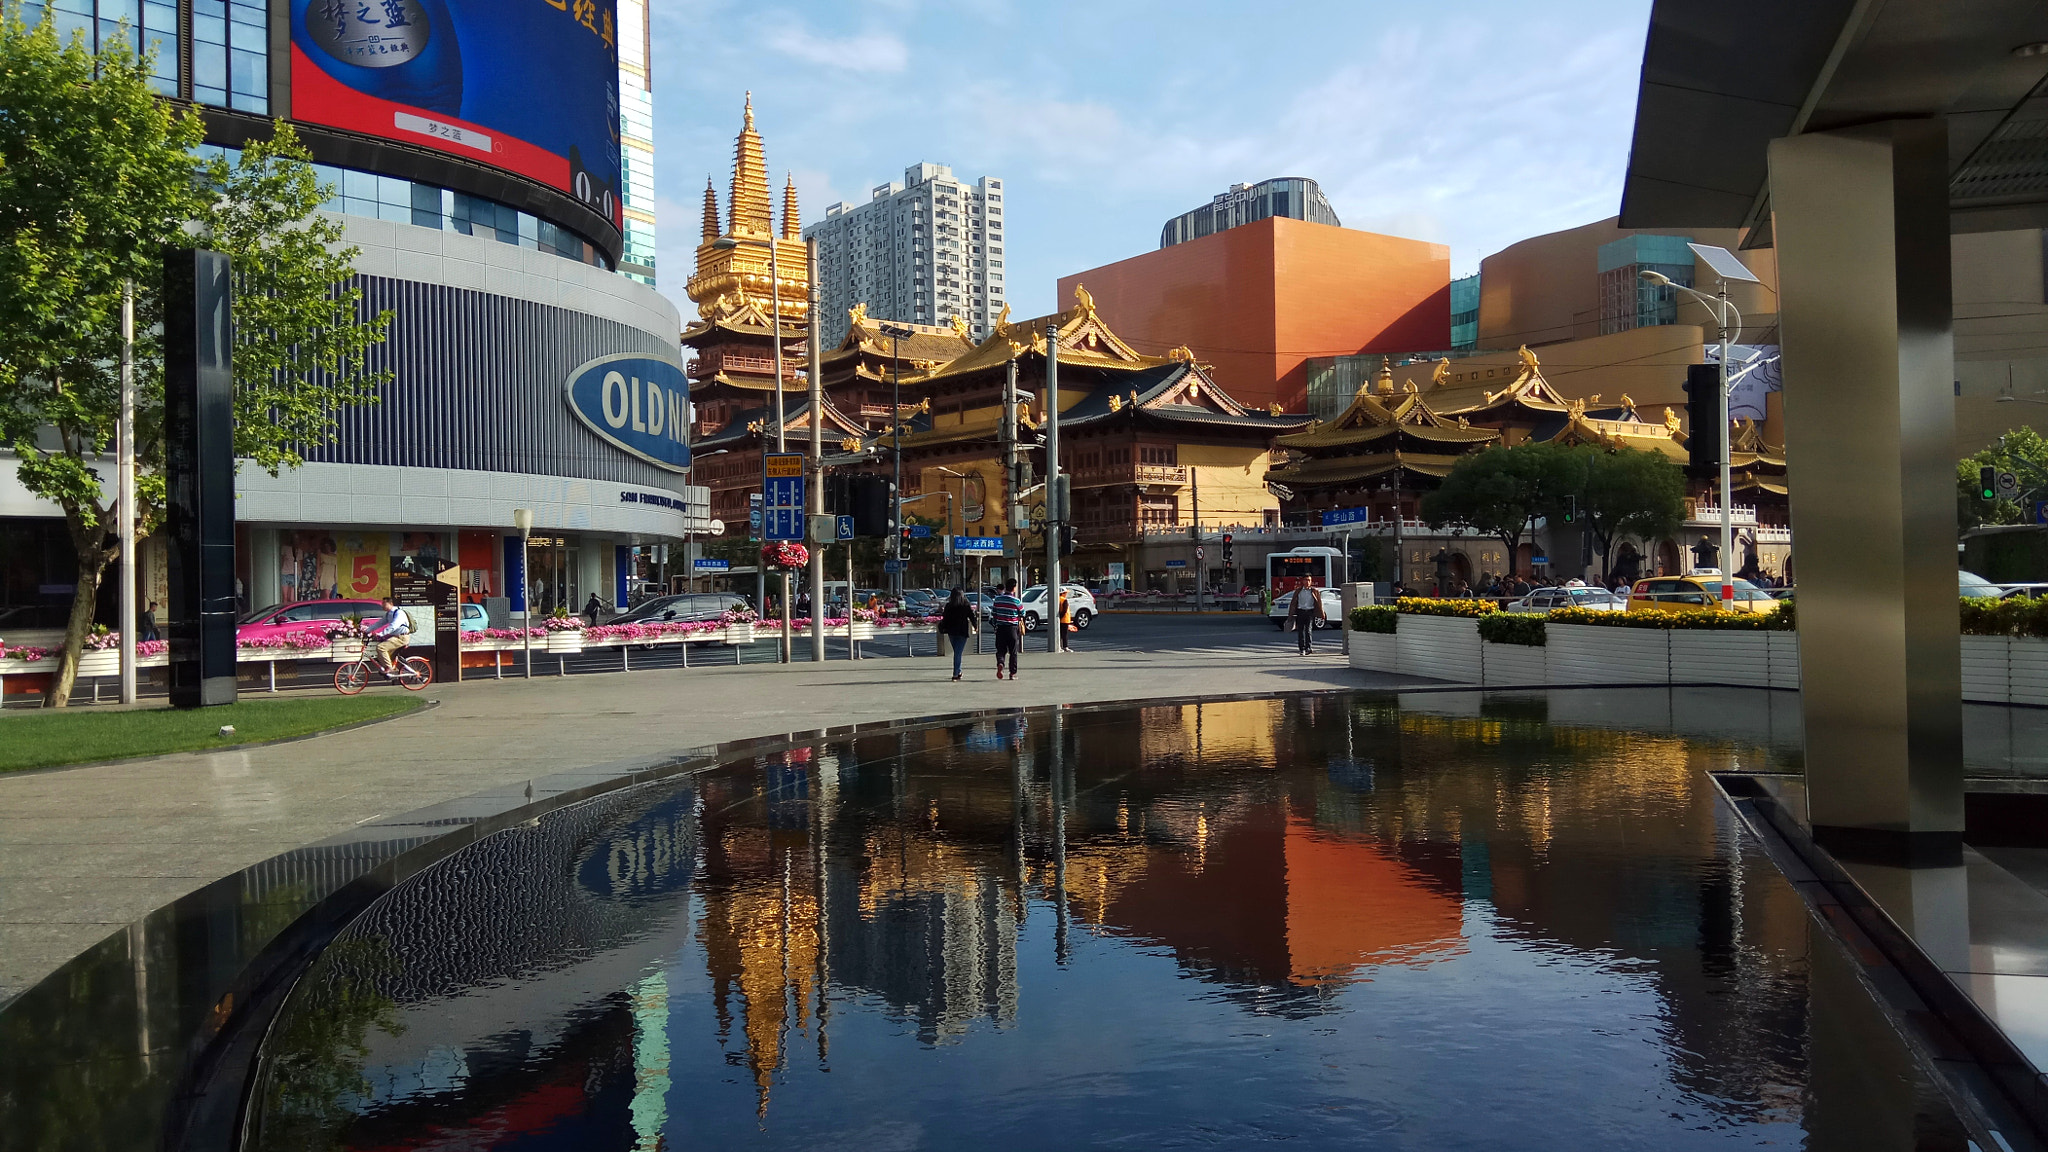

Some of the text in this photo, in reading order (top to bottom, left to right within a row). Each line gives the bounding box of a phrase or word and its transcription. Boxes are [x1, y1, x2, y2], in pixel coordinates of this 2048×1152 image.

[602, 370, 665, 436] OLD
[1332, 511, 1355, 523] 华山路
[965, 539, 995, 548] 南京西路
[351, 554, 379, 593] 5
